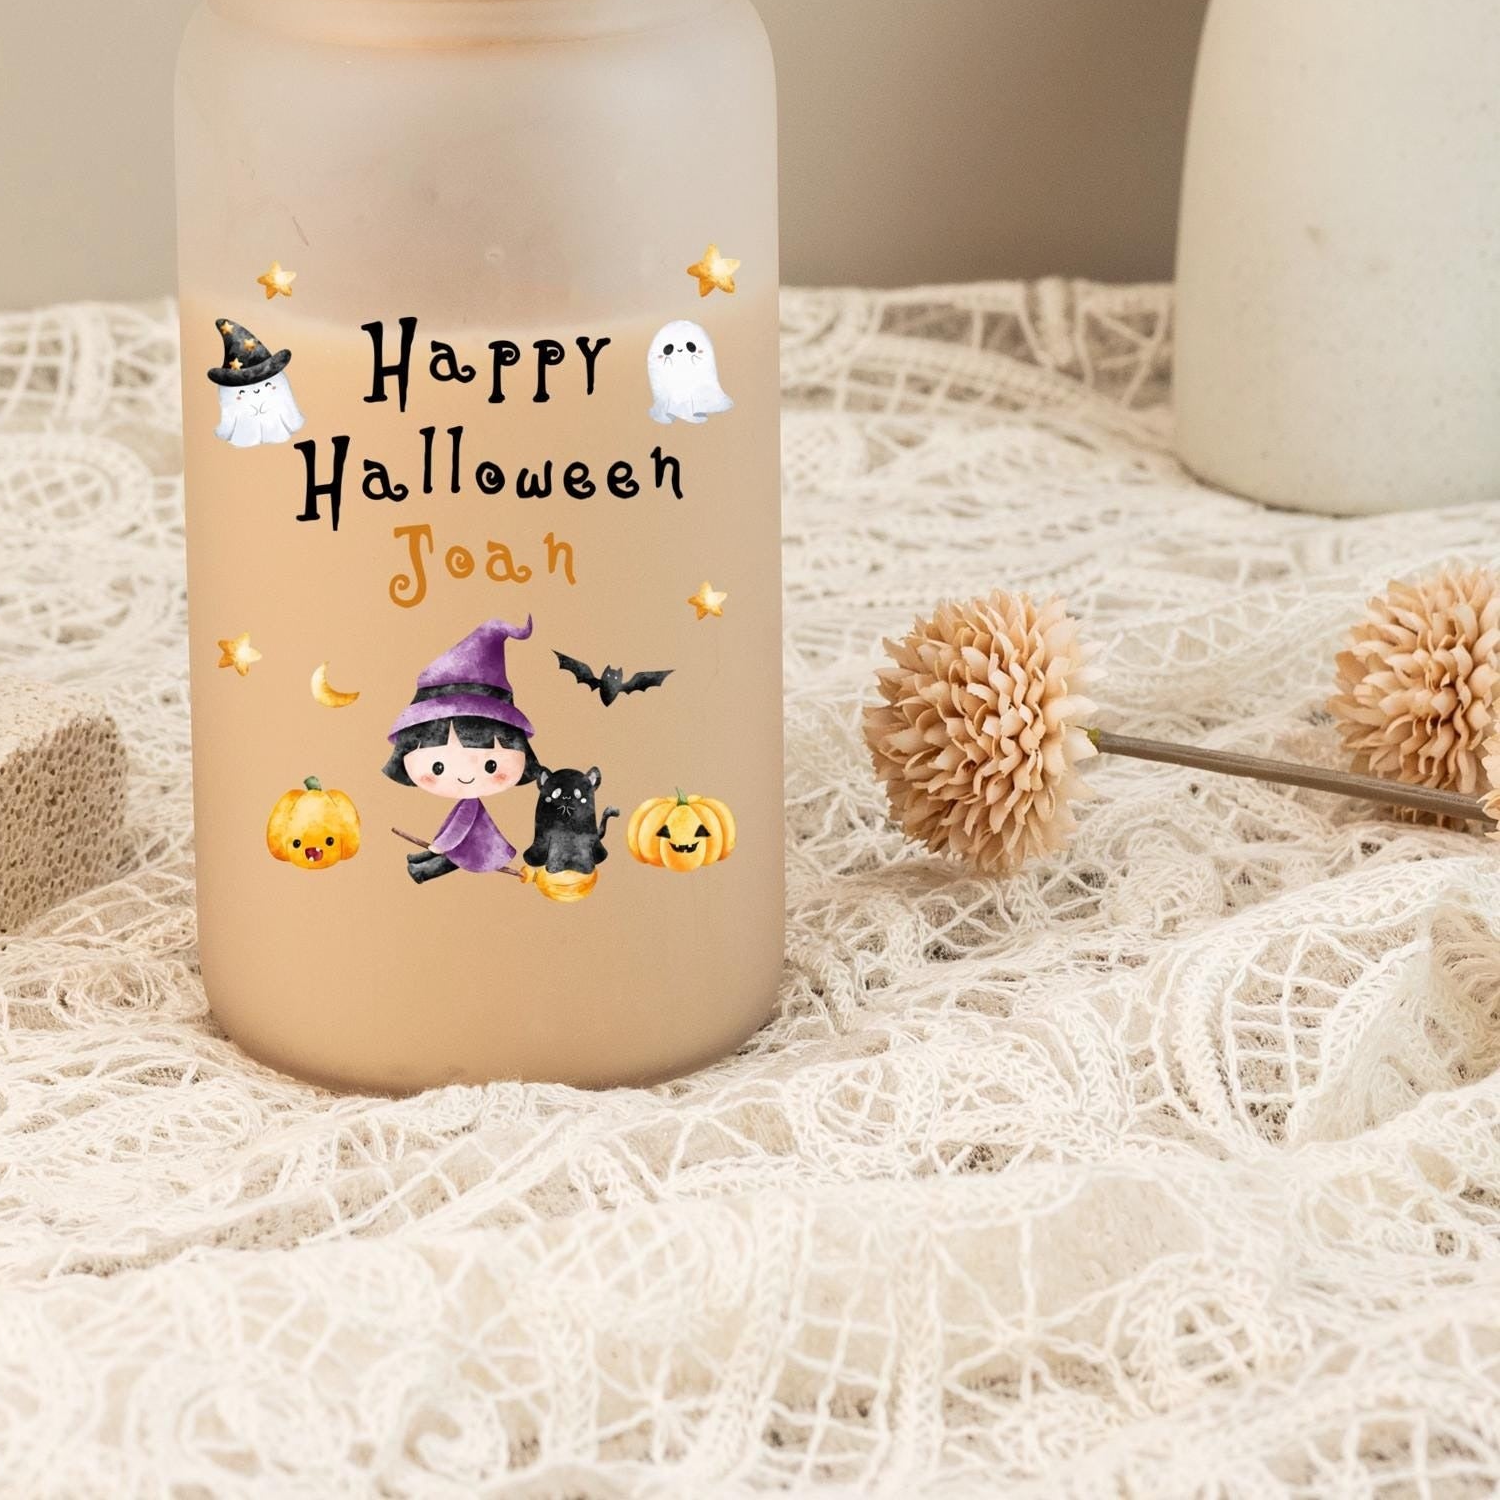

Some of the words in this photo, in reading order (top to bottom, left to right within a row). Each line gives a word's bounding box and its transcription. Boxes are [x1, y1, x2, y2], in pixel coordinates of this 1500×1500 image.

[361, 317, 611, 412] Happy
[294, 426, 684, 532] Halloween
[389, 524, 577, 609] Joan
